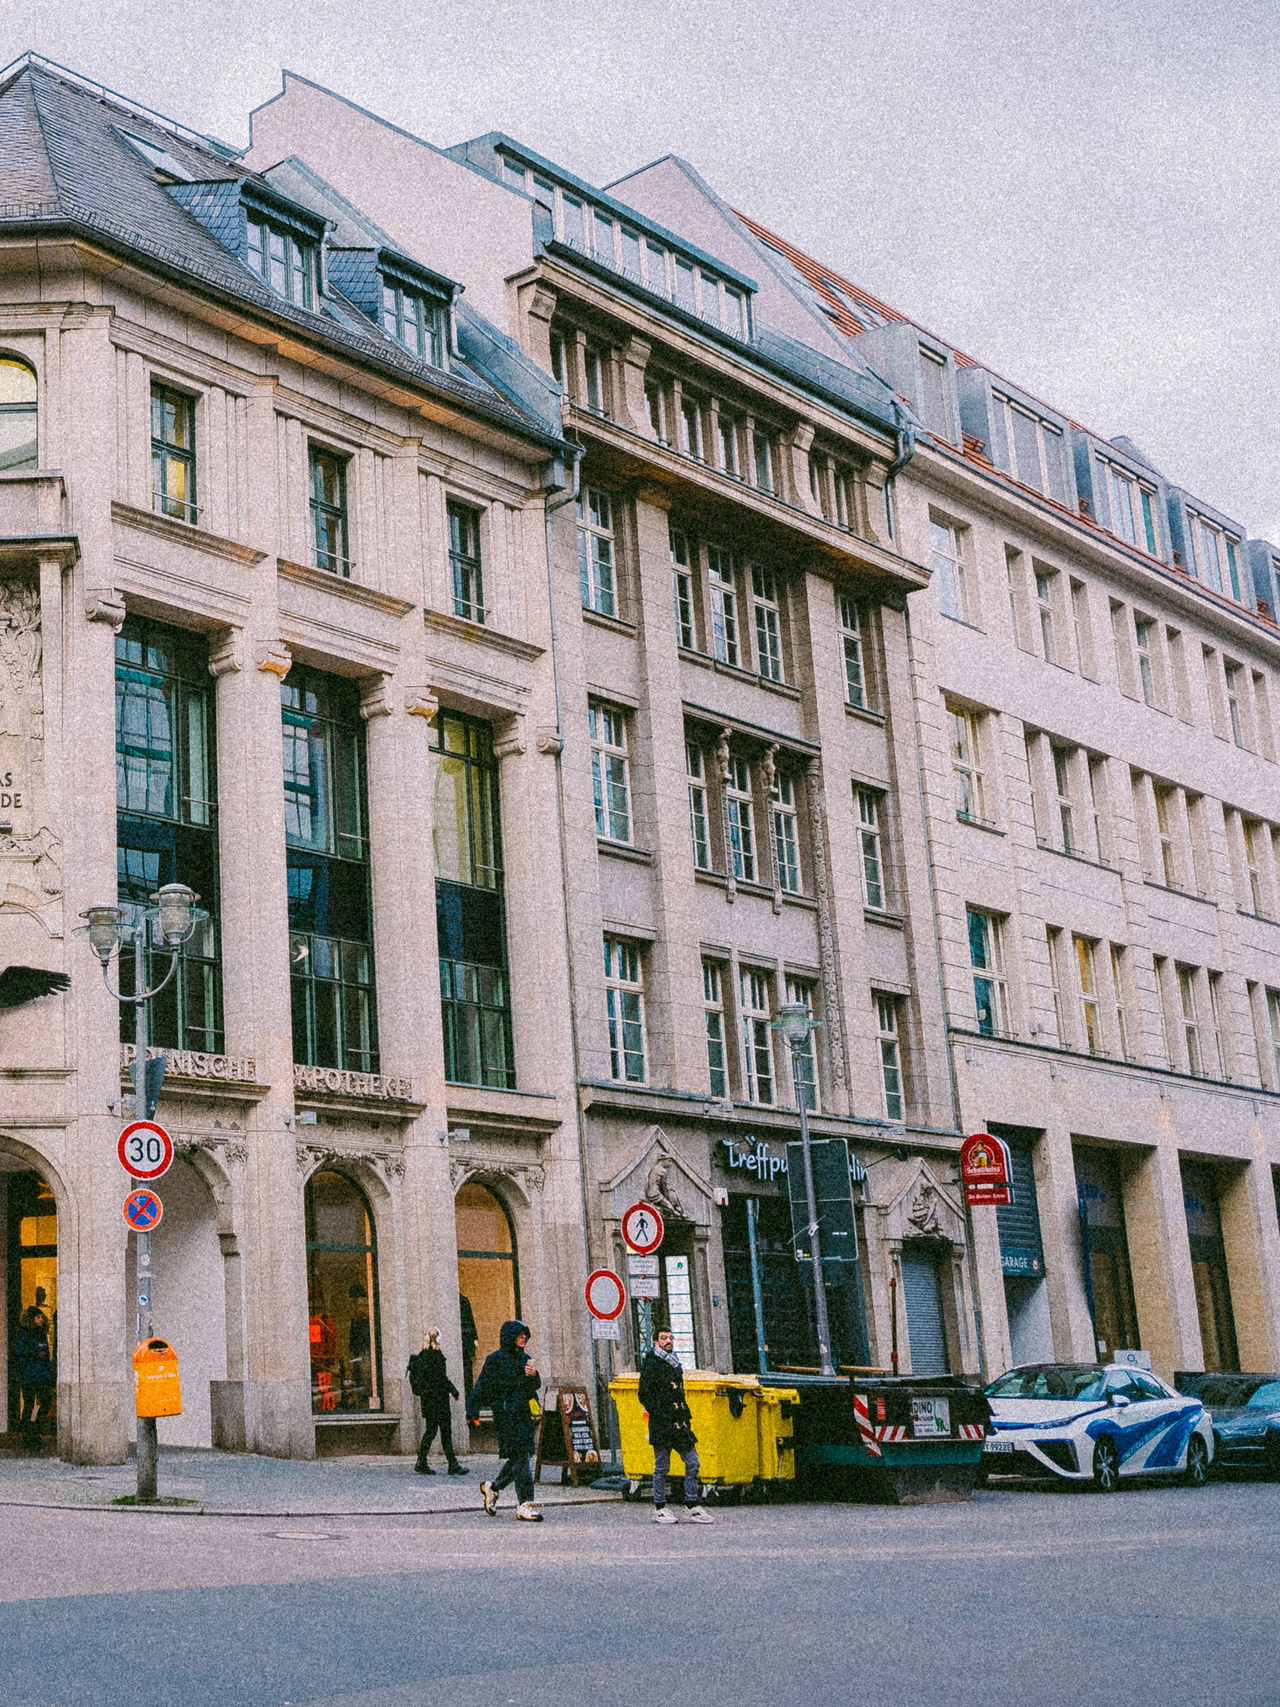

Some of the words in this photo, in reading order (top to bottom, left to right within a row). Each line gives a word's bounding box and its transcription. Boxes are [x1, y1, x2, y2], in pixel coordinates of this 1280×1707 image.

[122, 1044, 256, 1083] PNISCHE
[296, 1064, 413, 1101] APOTHEKE
[130, 1137, 161, 1163] 30
[722, 1139, 788, 1182] Treffpu
[913, 1401, 933, 1413] DINO
